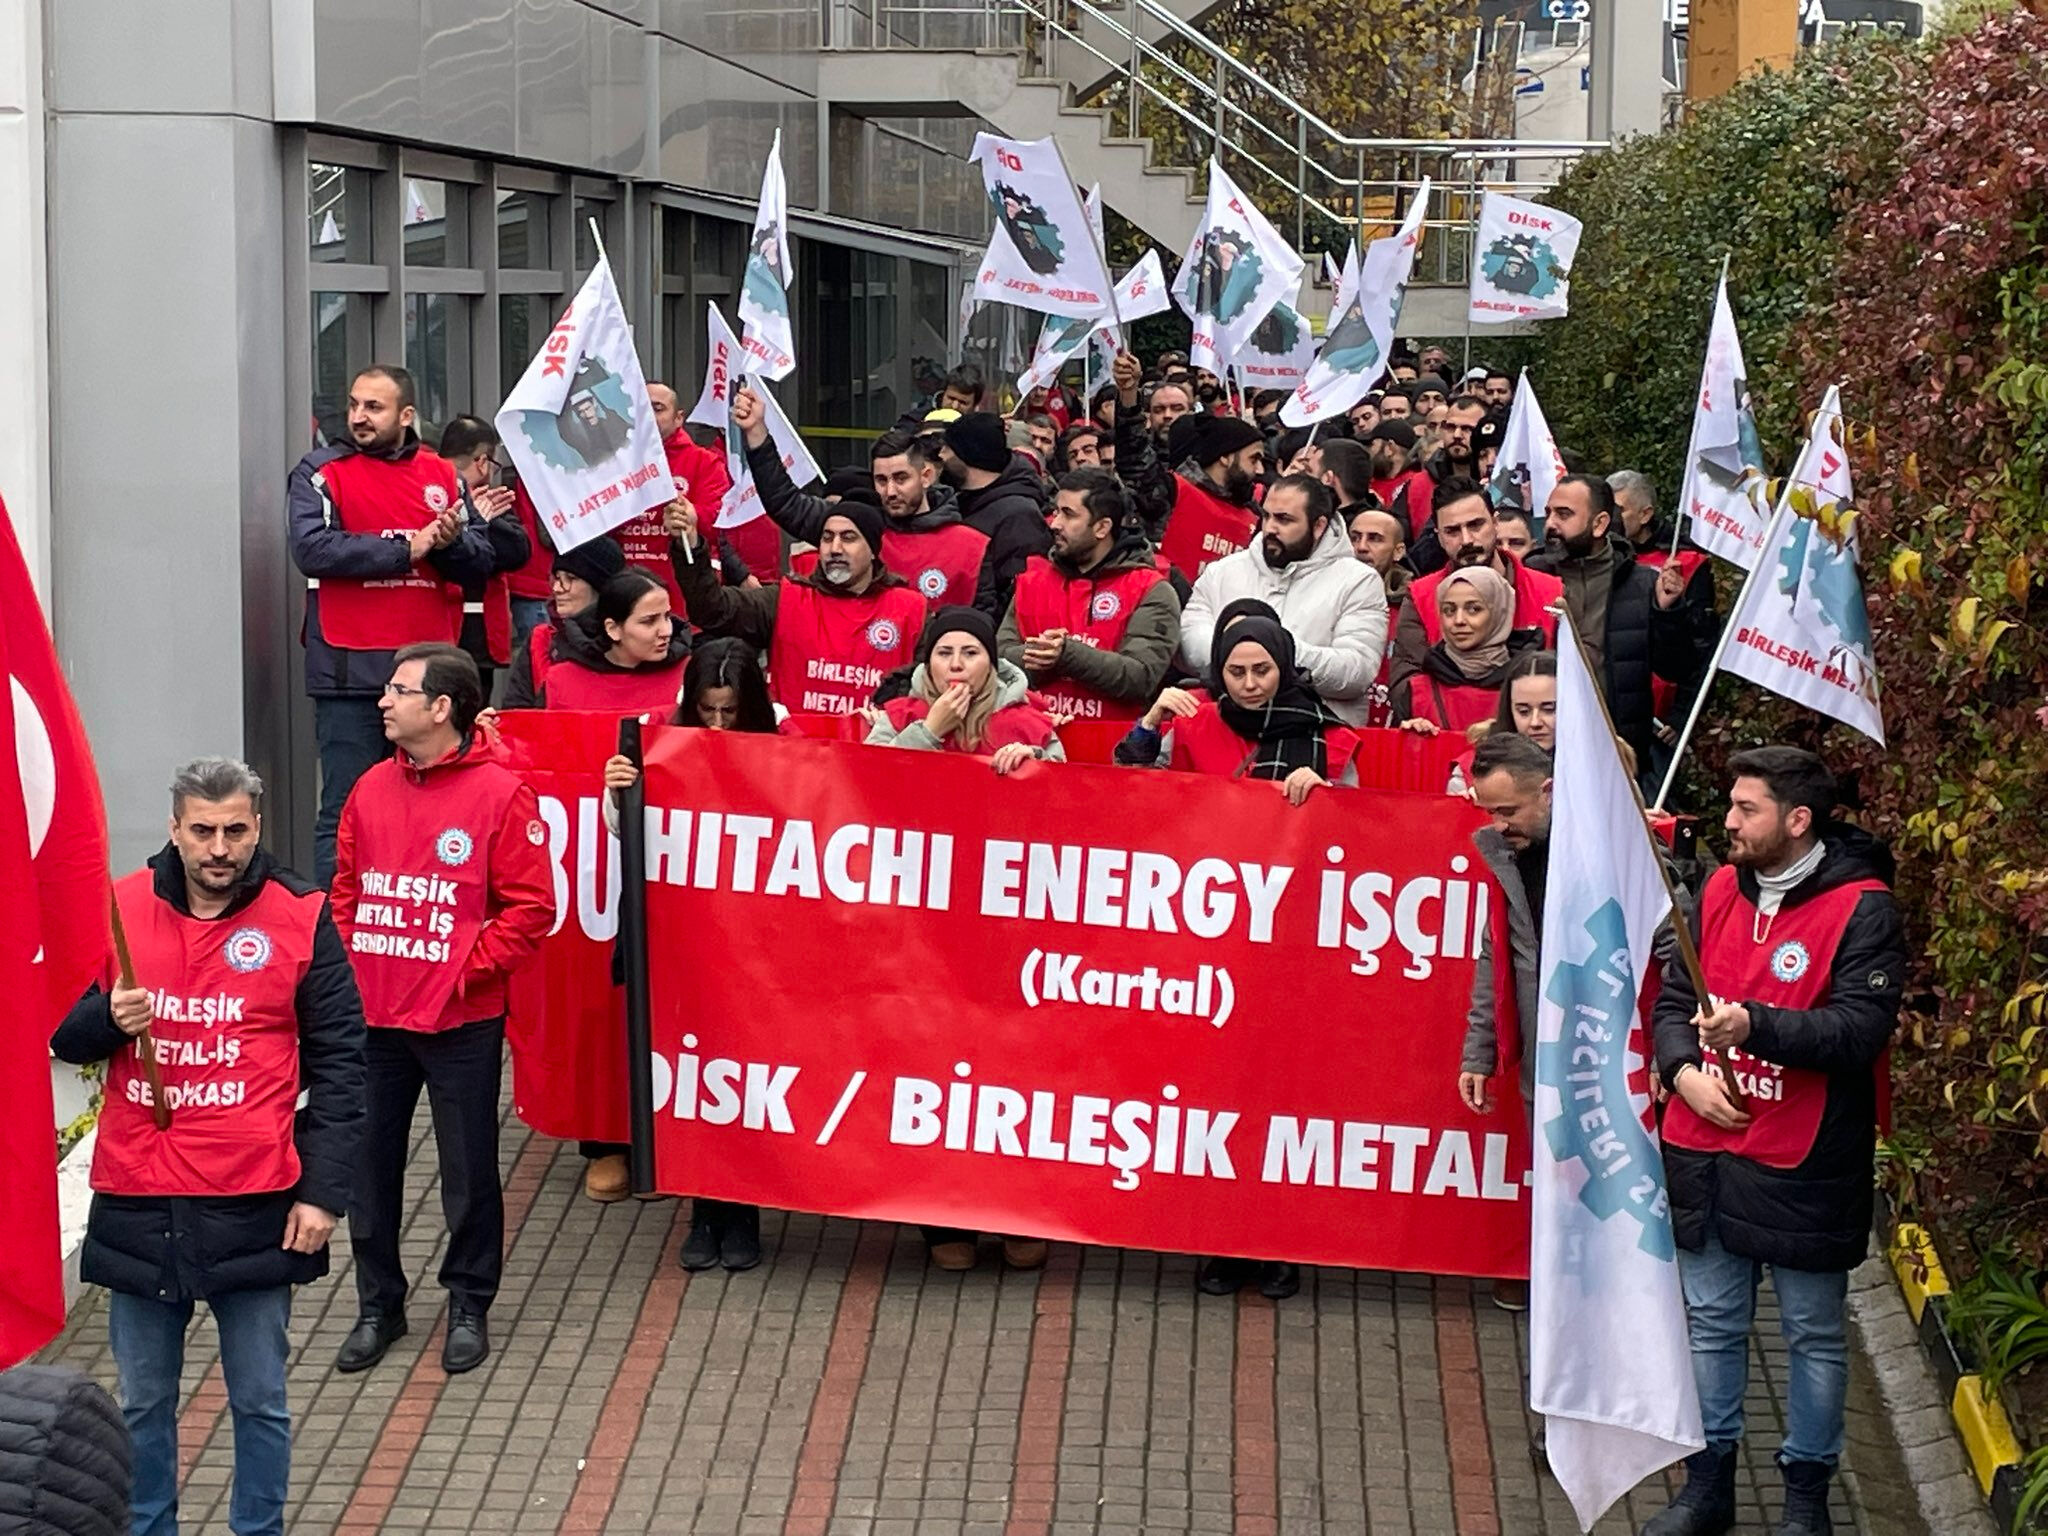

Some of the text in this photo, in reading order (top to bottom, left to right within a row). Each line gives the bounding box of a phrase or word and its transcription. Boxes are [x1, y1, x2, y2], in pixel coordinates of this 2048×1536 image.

[1508, 212, 1552, 231] DİSK
[1704, 508, 1745, 540] METAL
[1737, 627, 1821, 675] BİRLEŞİK
[807, 657, 884, 689] BİRLEŞİK
[803, 690, 855, 714] METAL
[644, 804, 955, 912] HITACHI
[980, 838, 1295, 944] ENERGY
[428, 906, 455, 940] İŞ
[1020, 947, 1236, 1029] (Kartal)
[126, 1078, 246, 1111] SEDİKASI
[815, 1070, 868, 1146] /
[889, 1061, 1241, 1190] BİRLEŞİK
